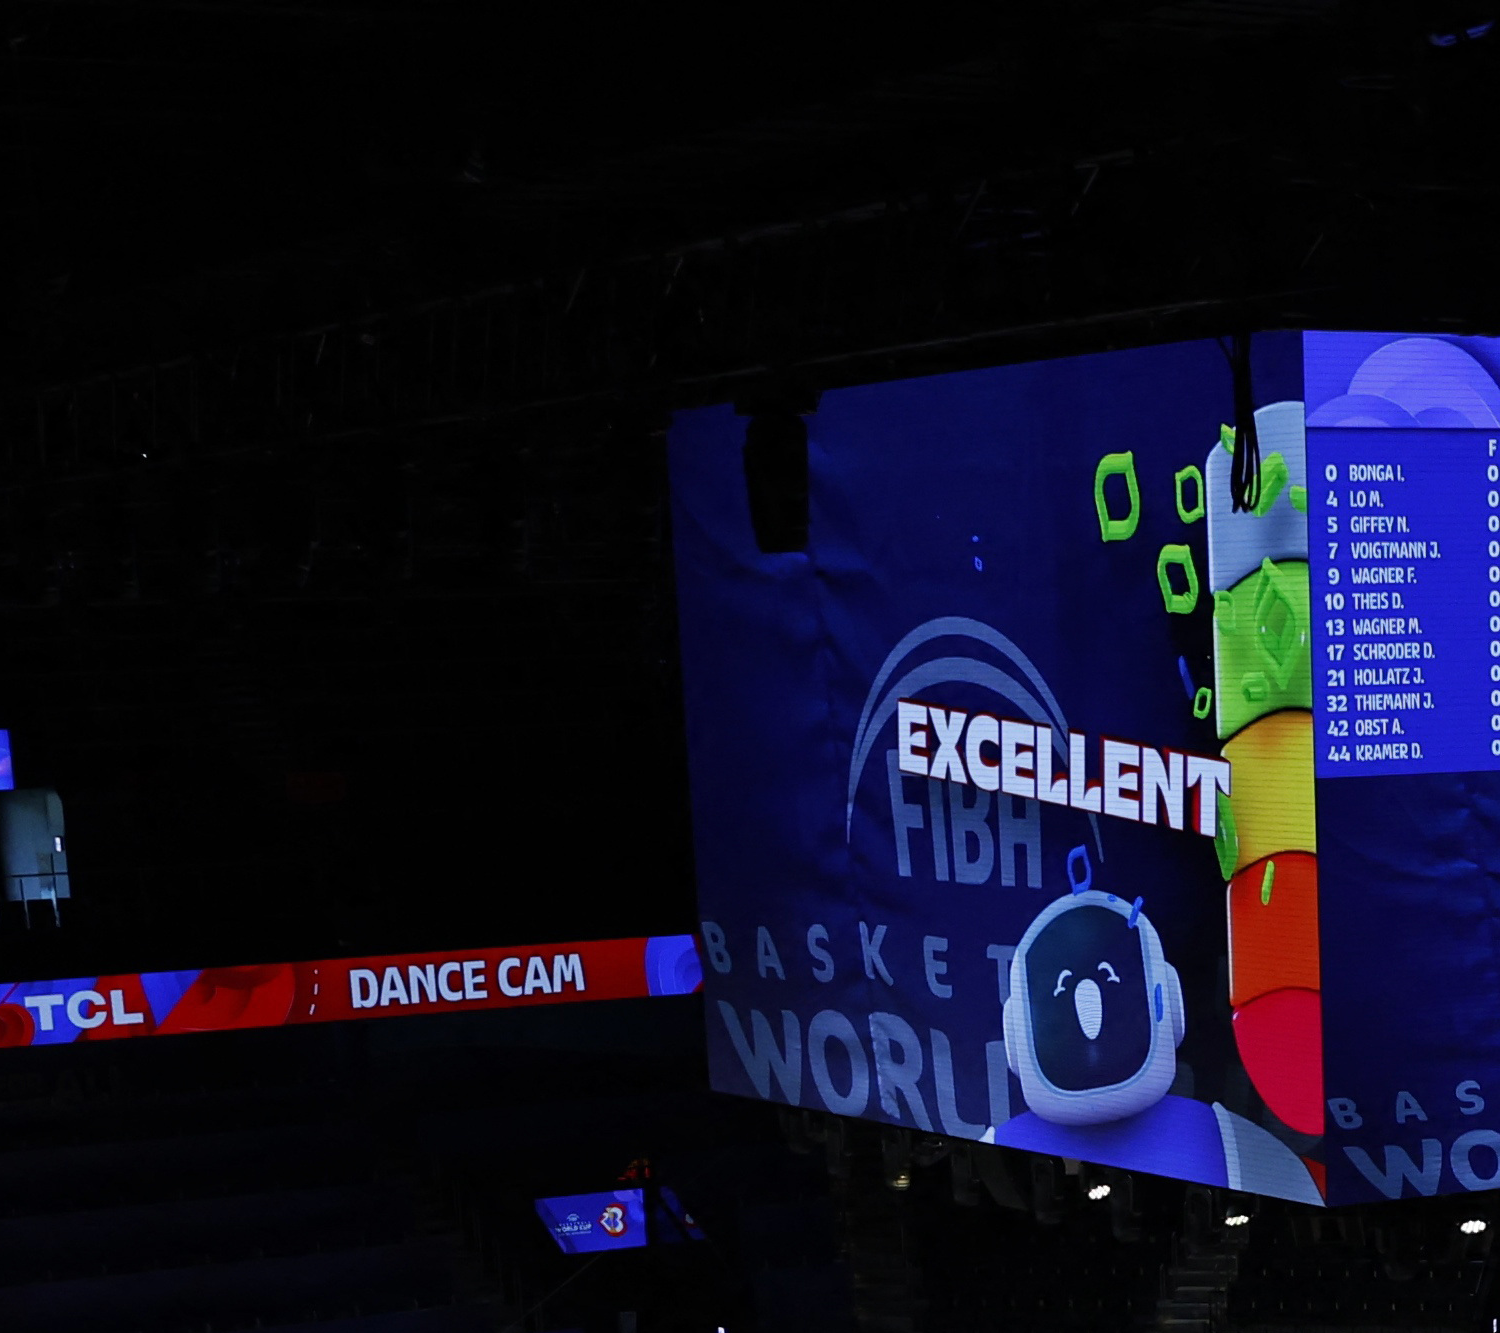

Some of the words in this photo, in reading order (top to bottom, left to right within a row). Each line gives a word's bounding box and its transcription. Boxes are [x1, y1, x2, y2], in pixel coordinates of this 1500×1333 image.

[1326, 465, 1337, 481] 0
[1350, 465, 1394, 481] BONGA
[1397, 465, 1404, 481] I.
[1327, 491, 1337, 507] 4
[1350, 491, 1366, 507] LO
[1370, 491, 1383, 507] M.
[1328, 517, 1337, 533] 5
[1351, 516, 1394, 533] GIFFEY
[1397, 516, 1409, 532] N.
[1329, 543, 1338, 559] 7
[1351, 542, 1426, 559] VOIGTMANN
[1430, 542, 1440, 558] J.
[1328, 568, 1339, 585] 9
[1352, 567, 1401, 584] WAGNER
[1407, 567, 1416, 583] F.
[1325, 593, 1344, 610] 10
[1352, 592, 1388, 609] THEIS
[1392, 593, 1404, 608] D.
[1326, 619, 1344, 635] 13
[1353, 618, 1405, 635] WAGNER
[1409, 618, 1422, 634] M.
[1327, 645, 1344, 660] 17
[1354, 643, 1420, 660] SCHRODER
[1424, 642, 1435, 658] D.
[1328, 670, 1344, 686] 21
[1354, 668, 1410, 685] HOLLATZ
[1413, 668, 1424, 683] J.
[1327, 695, 1347, 712] 32
[1355, 693, 1420, 711] THIEMANN
[1423, 693, 1434, 708] J.
[1328, 720, 1348, 736] 42
[1355, 719, 1388, 736] OBST
[1392, 718, 1404, 734] A.
[1328, 746, 1350, 761] 44
[1356, 743, 1408, 761] KRAMER
[1412, 743, 1423, 758] D.
[898, 700, 1231, 837] EXCELLENT
[350, 961, 487, 1008] DANCE
[498, 954, 585, 996] CAM
[24, 990, 143, 1030] TCL
